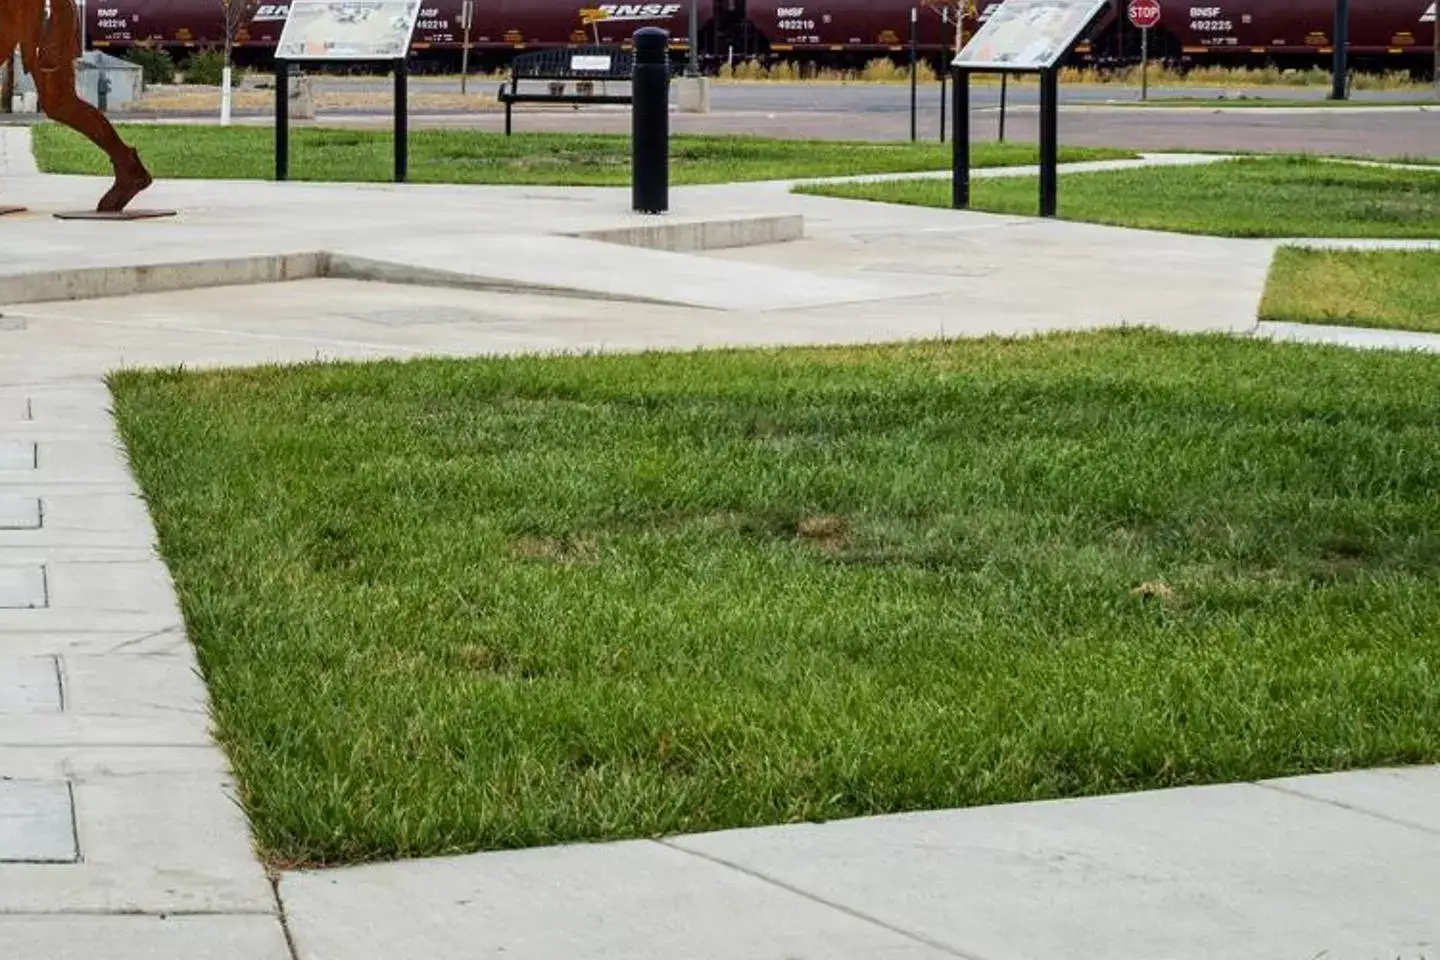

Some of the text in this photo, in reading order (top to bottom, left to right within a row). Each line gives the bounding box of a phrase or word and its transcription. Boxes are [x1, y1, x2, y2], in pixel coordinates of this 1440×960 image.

[419, 8, 439, 18] NSF
[777, 7, 804, 17] BNSF
[1129, 6, 1160, 19] STOP
[1189, 7, 1221, 18] BNSF
